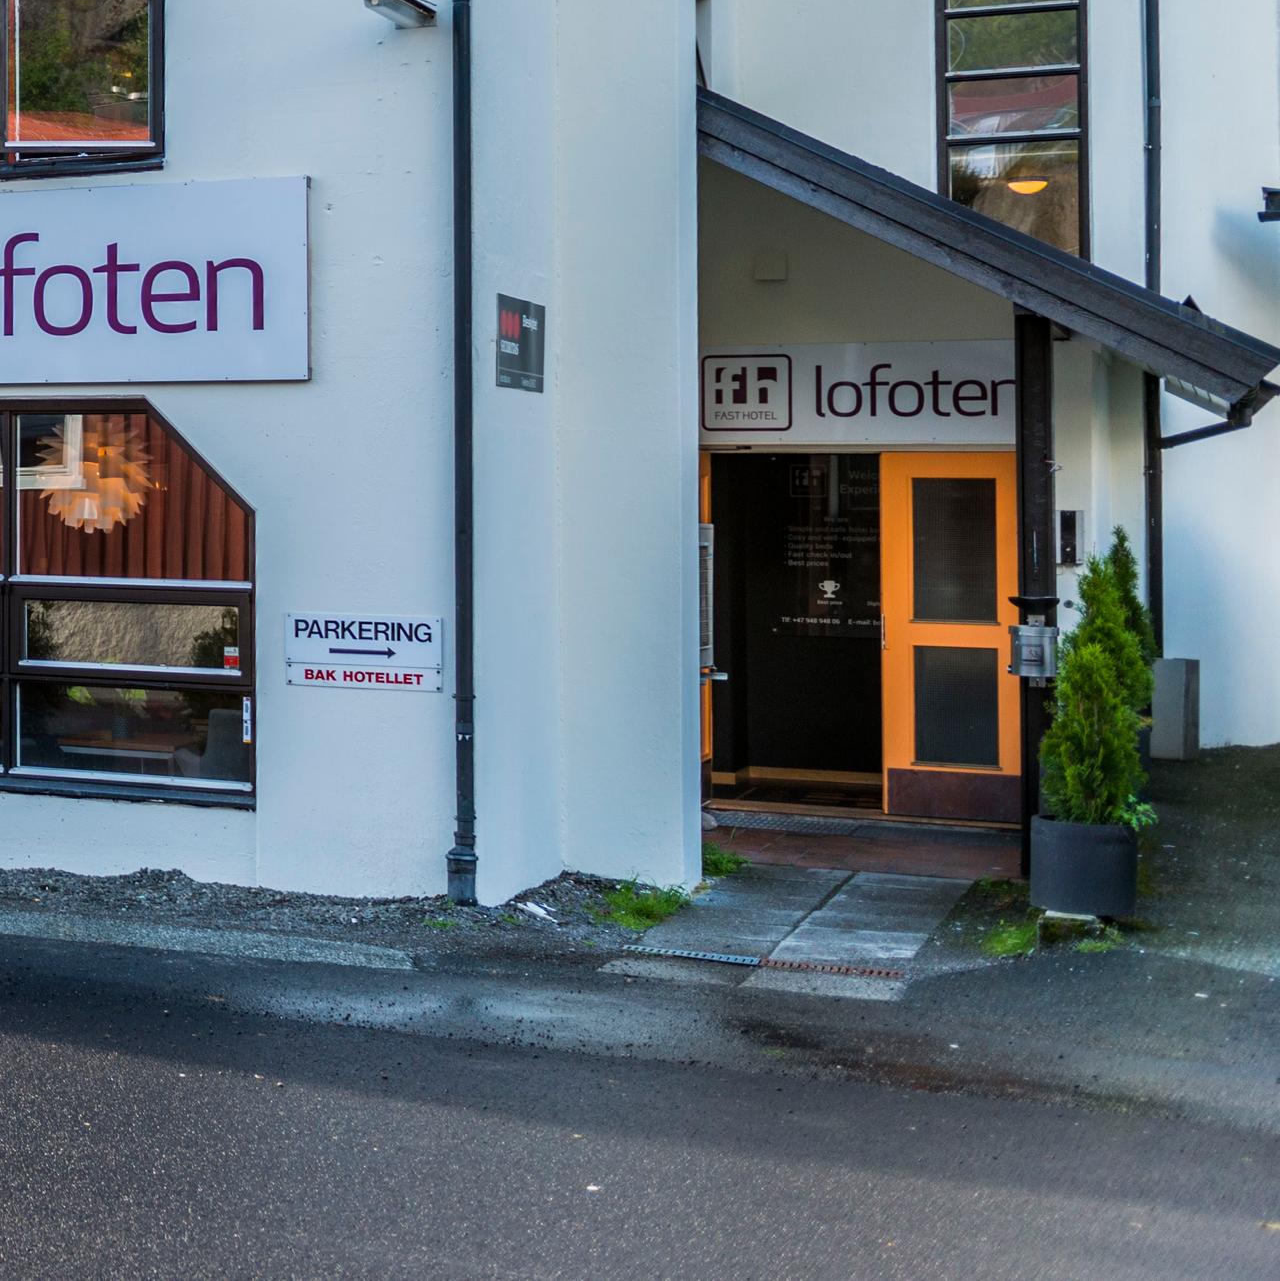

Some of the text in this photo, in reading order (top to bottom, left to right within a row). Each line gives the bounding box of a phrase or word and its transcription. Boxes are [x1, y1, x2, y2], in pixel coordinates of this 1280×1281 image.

[714, 410, 778, 421] FAST HOTEL
[293, 618, 433, 643] PARKERING
[304, 668, 424, 685] BAK HOTELLET
